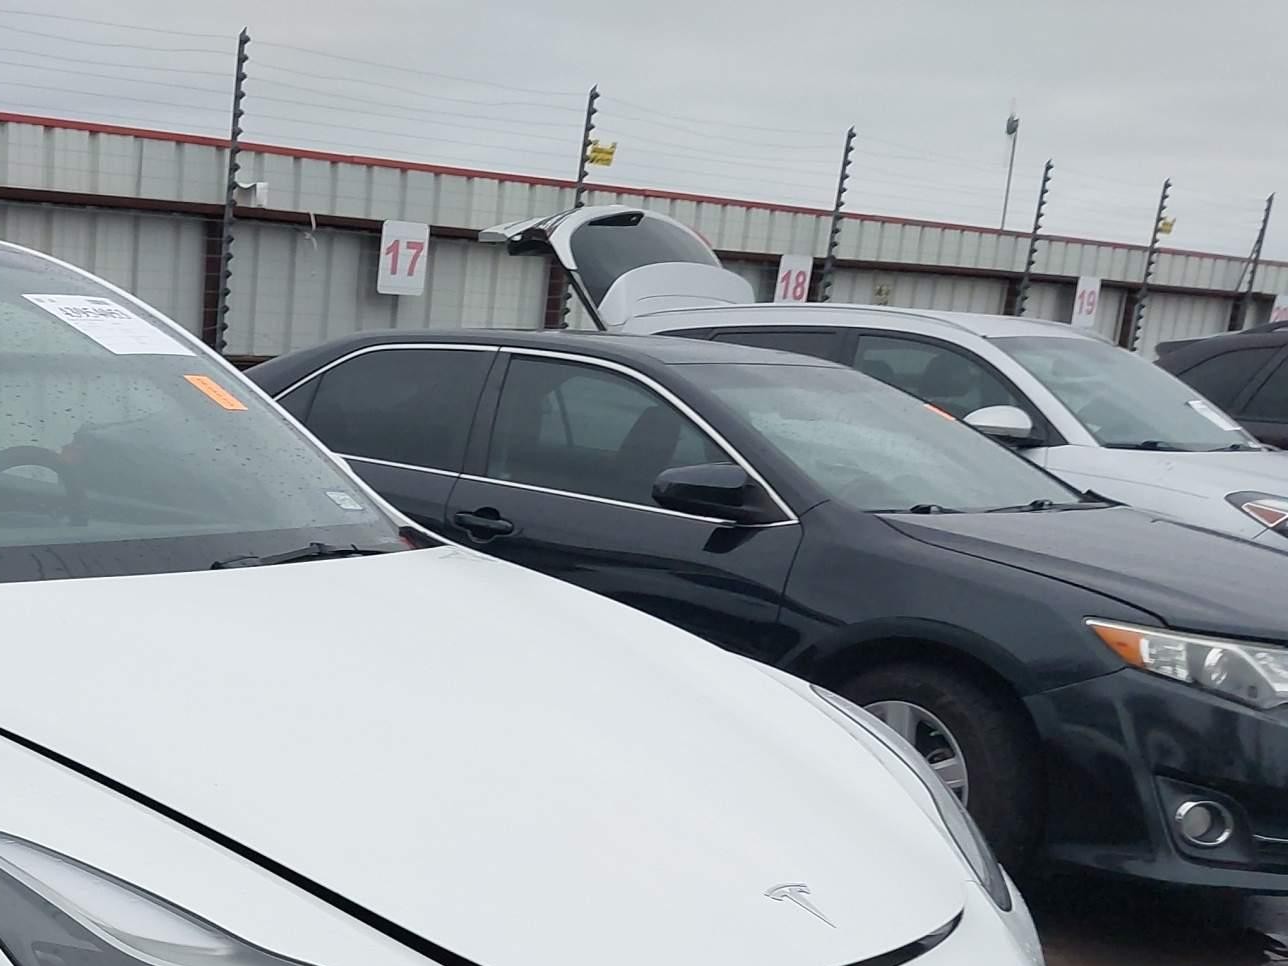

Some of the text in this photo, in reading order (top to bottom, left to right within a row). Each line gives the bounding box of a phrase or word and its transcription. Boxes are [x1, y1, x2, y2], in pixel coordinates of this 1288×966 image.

[385, 239, 425, 276] 17
[780, 269, 807, 301] 18
[1078, 289, 1097, 315] 19
